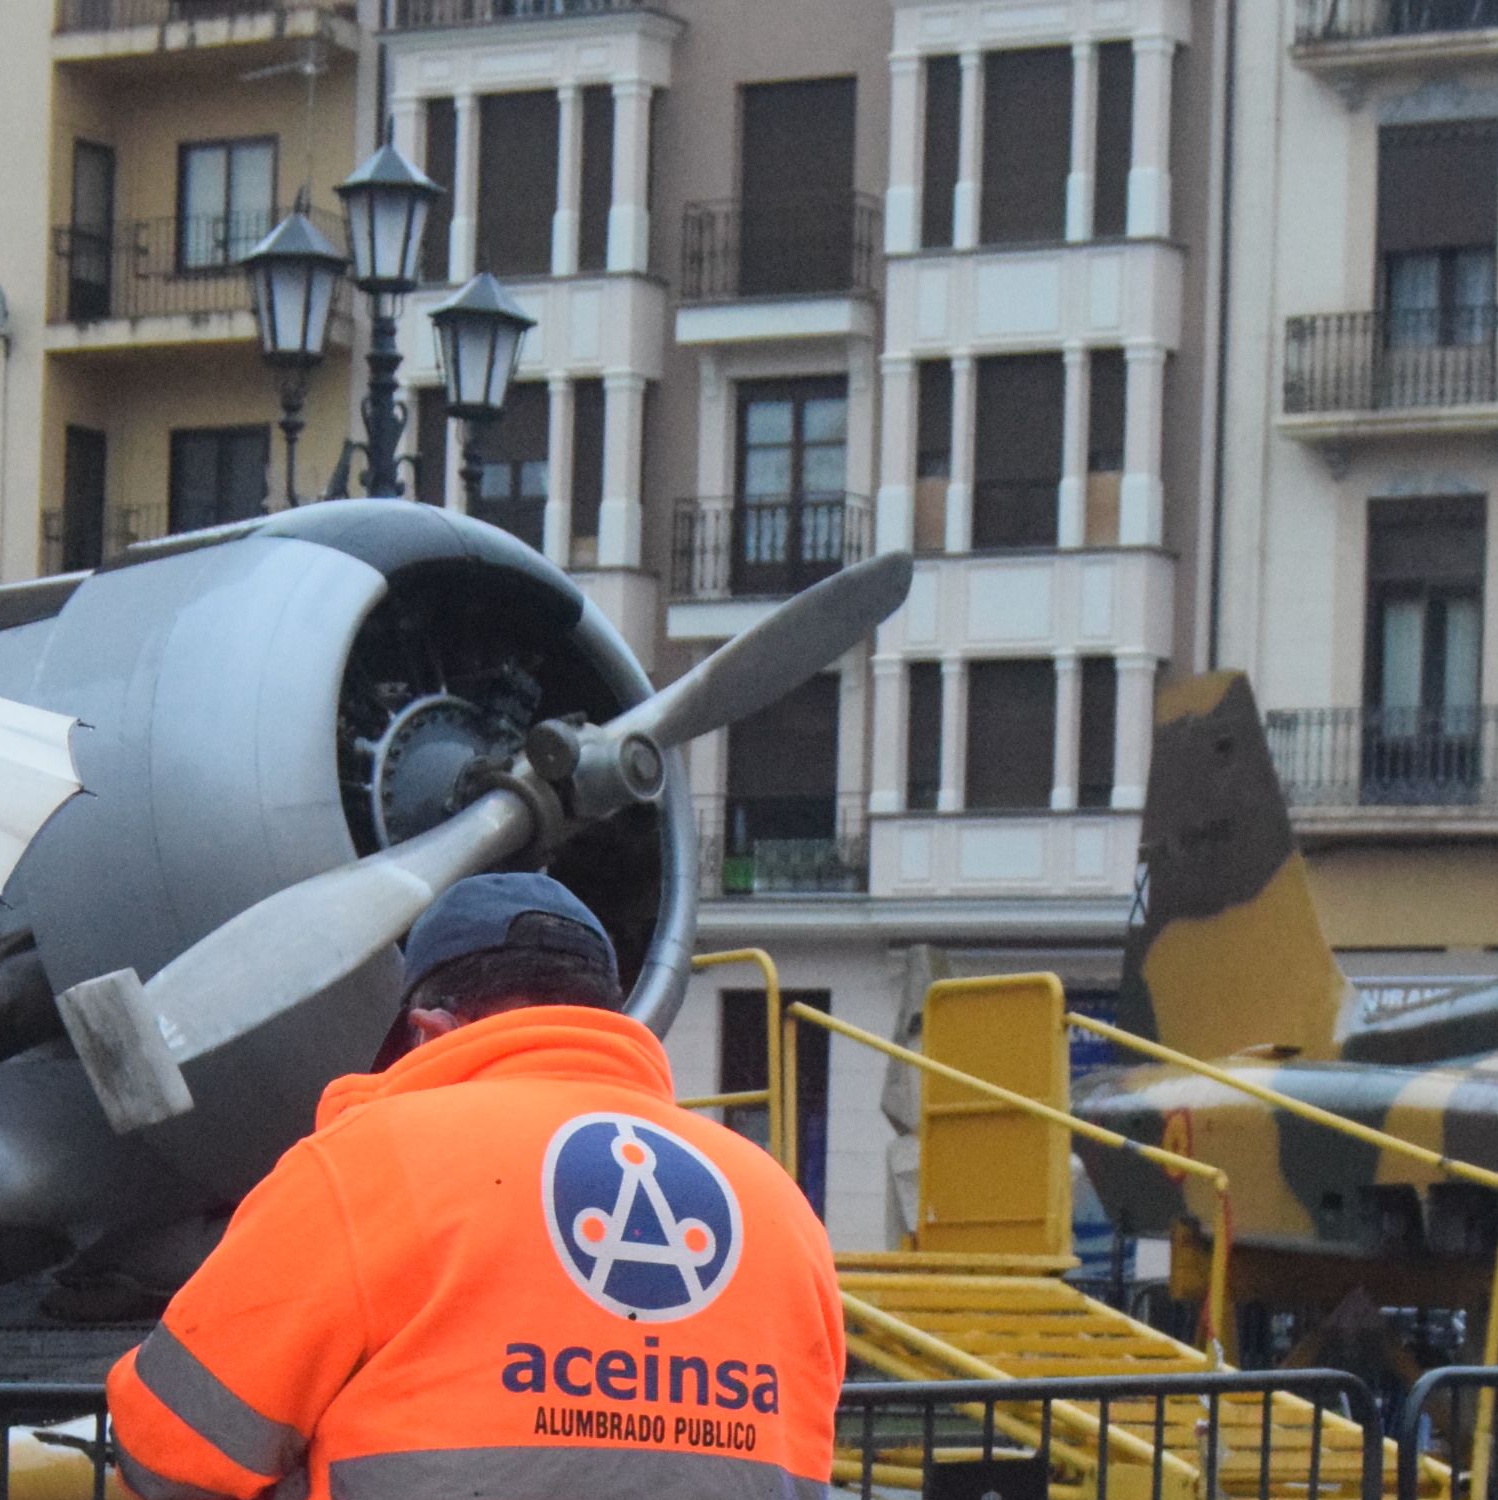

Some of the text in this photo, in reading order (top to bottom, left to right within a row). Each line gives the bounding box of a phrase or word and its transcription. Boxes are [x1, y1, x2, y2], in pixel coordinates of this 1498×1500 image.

[501, 1336, 780, 1415] aceinsa
[534, 1405, 757, 1453] ALUMBRADO PUBLICO
